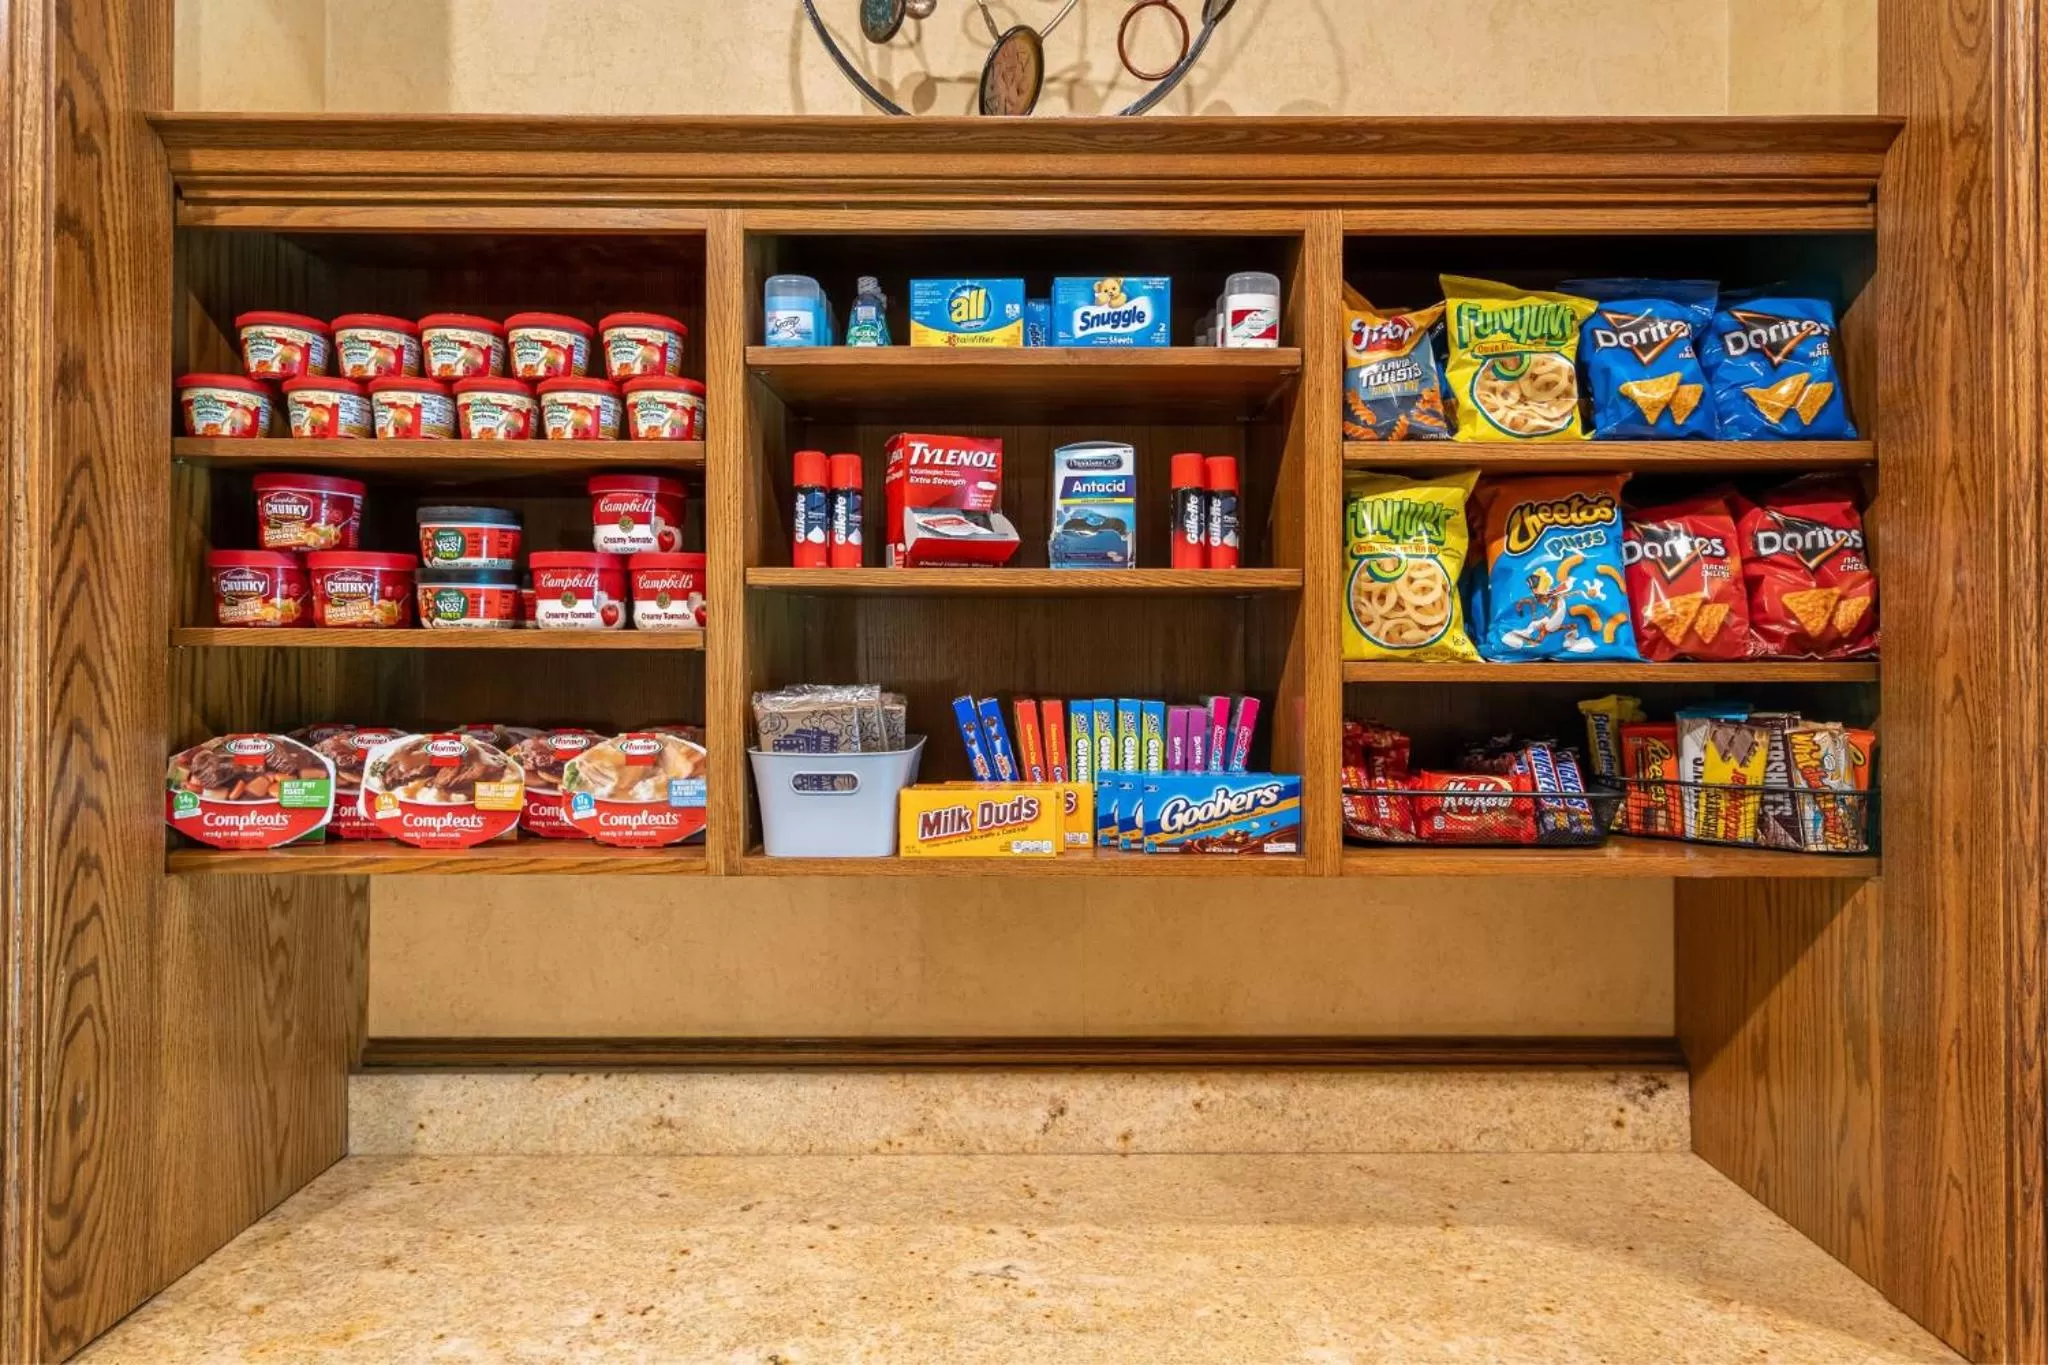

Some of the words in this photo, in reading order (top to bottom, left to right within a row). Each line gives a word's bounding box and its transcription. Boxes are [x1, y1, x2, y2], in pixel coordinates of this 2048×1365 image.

[951, 288, 986, 322] all
[1079, 306, 1146, 332] Snuggle
[1457, 302, 1575, 349] FUNYUNS
[908, 442, 998, 468] TYLENOL
[910, 476, 931, 485] Extra
[932, 477, 967, 489] Strength
[1073, 480, 1126, 493] Antacid
[265, 503, 309, 517] CHUNKY
[598, 497, 656, 515] Campbell's
[795, 492, 806, 543] Gillette
[834, 494, 847, 545] Gillette
[1186, 494, 1199, 544] Gillette
[1210, 497, 1222, 546] Gillette
[1506, 494, 1615, 552] Cheetos
[435, 536, 462, 552] Yes!
[604, 536, 626, 545] Creamy
[627, 536, 654, 545] Tomato
[1757, 527, 1864, 556] Doritos
[1622, 537, 1726, 565] Doritos
[220, 579, 264, 592] CHUNKY
[327, 582, 374, 595] CHUNKY
[541, 572, 600, 589] Campbell's
[637, 574, 693, 591] Campbell's
[437, 597, 464, 612] Yes!
[545, 611, 569, 620] Creamy
[570, 611, 596, 620] Tomato
[641, 613, 662, 621] Creamy
[233, 740, 268, 752] Hormel
[429, 743, 462, 753] Hormel
[555, 736, 584, 746] Hormel
[625, 742, 658, 751] Hormel
[1193, 735, 1202, 765] Skittles
[1160, 784, 1280, 832] Goobers
[203, 810, 289, 831] Compleats
[402, 812, 484, 831] Compleats
[600, 810, 678, 829] Compleats
[919, 805, 973, 839] Milk
[978, 796, 1040, 828] Duds
